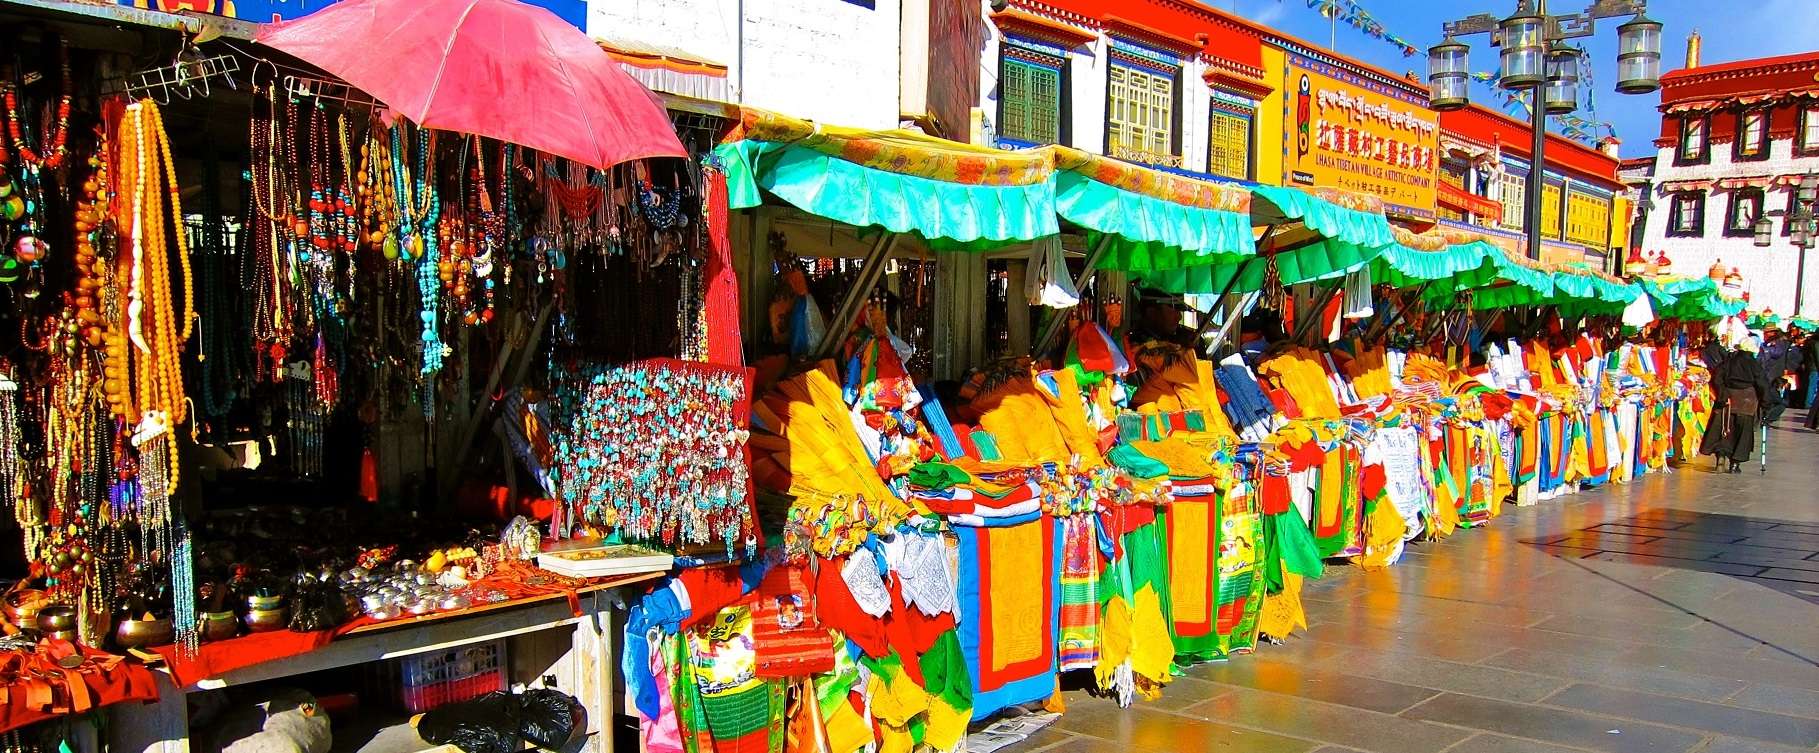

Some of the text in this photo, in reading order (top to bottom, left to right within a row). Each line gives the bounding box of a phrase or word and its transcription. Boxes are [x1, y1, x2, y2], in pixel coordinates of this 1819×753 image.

[1315, 153, 1430, 188] LHASA TIBETAN VILLAGE ARTISTIC COMPANY
